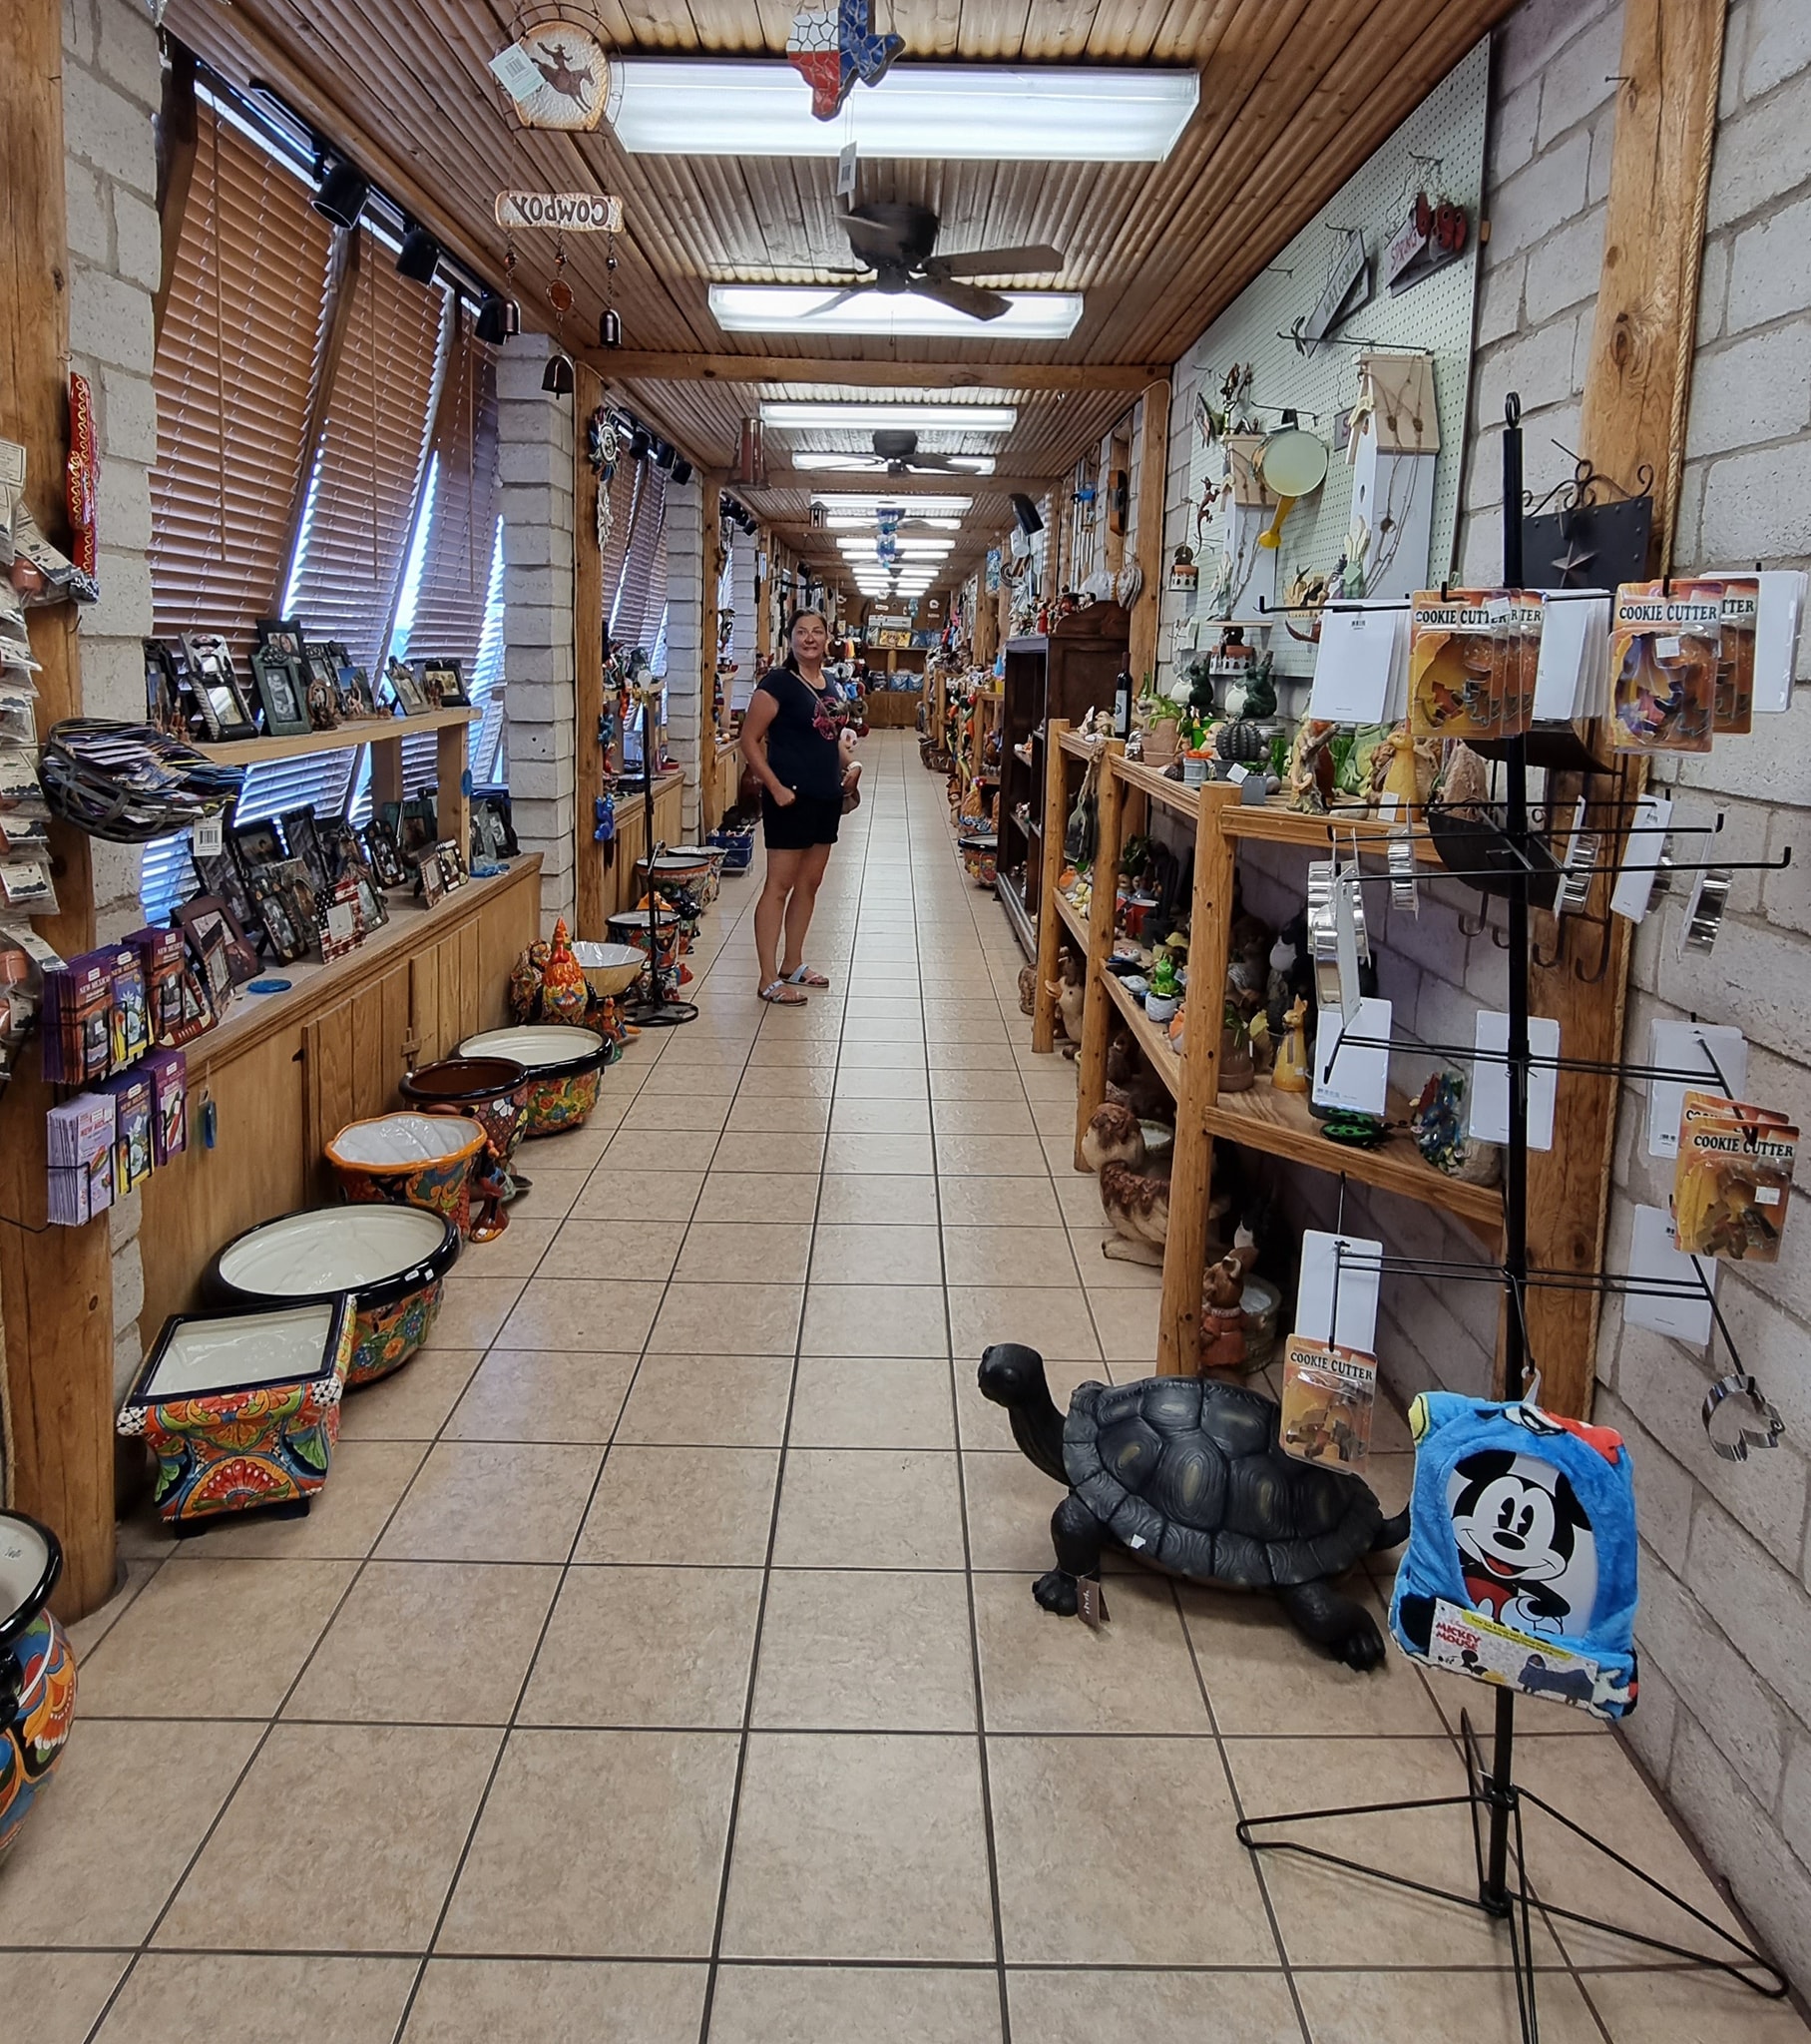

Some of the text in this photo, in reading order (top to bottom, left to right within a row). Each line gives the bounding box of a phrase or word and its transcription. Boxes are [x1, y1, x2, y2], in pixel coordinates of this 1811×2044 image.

[1415, 609, 1457, 624] COOKIE
[1619, 605, 1717, 621] COOKIE CUTTER
[1693, 1135, 1793, 1157] COOKIE CUTTER
[1290, 1352, 1373, 1380] COOKIE CUTTER
[1435, 1622, 1482, 1643] MICKEY
[1435, 1632, 1478, 1652] MOUSE
